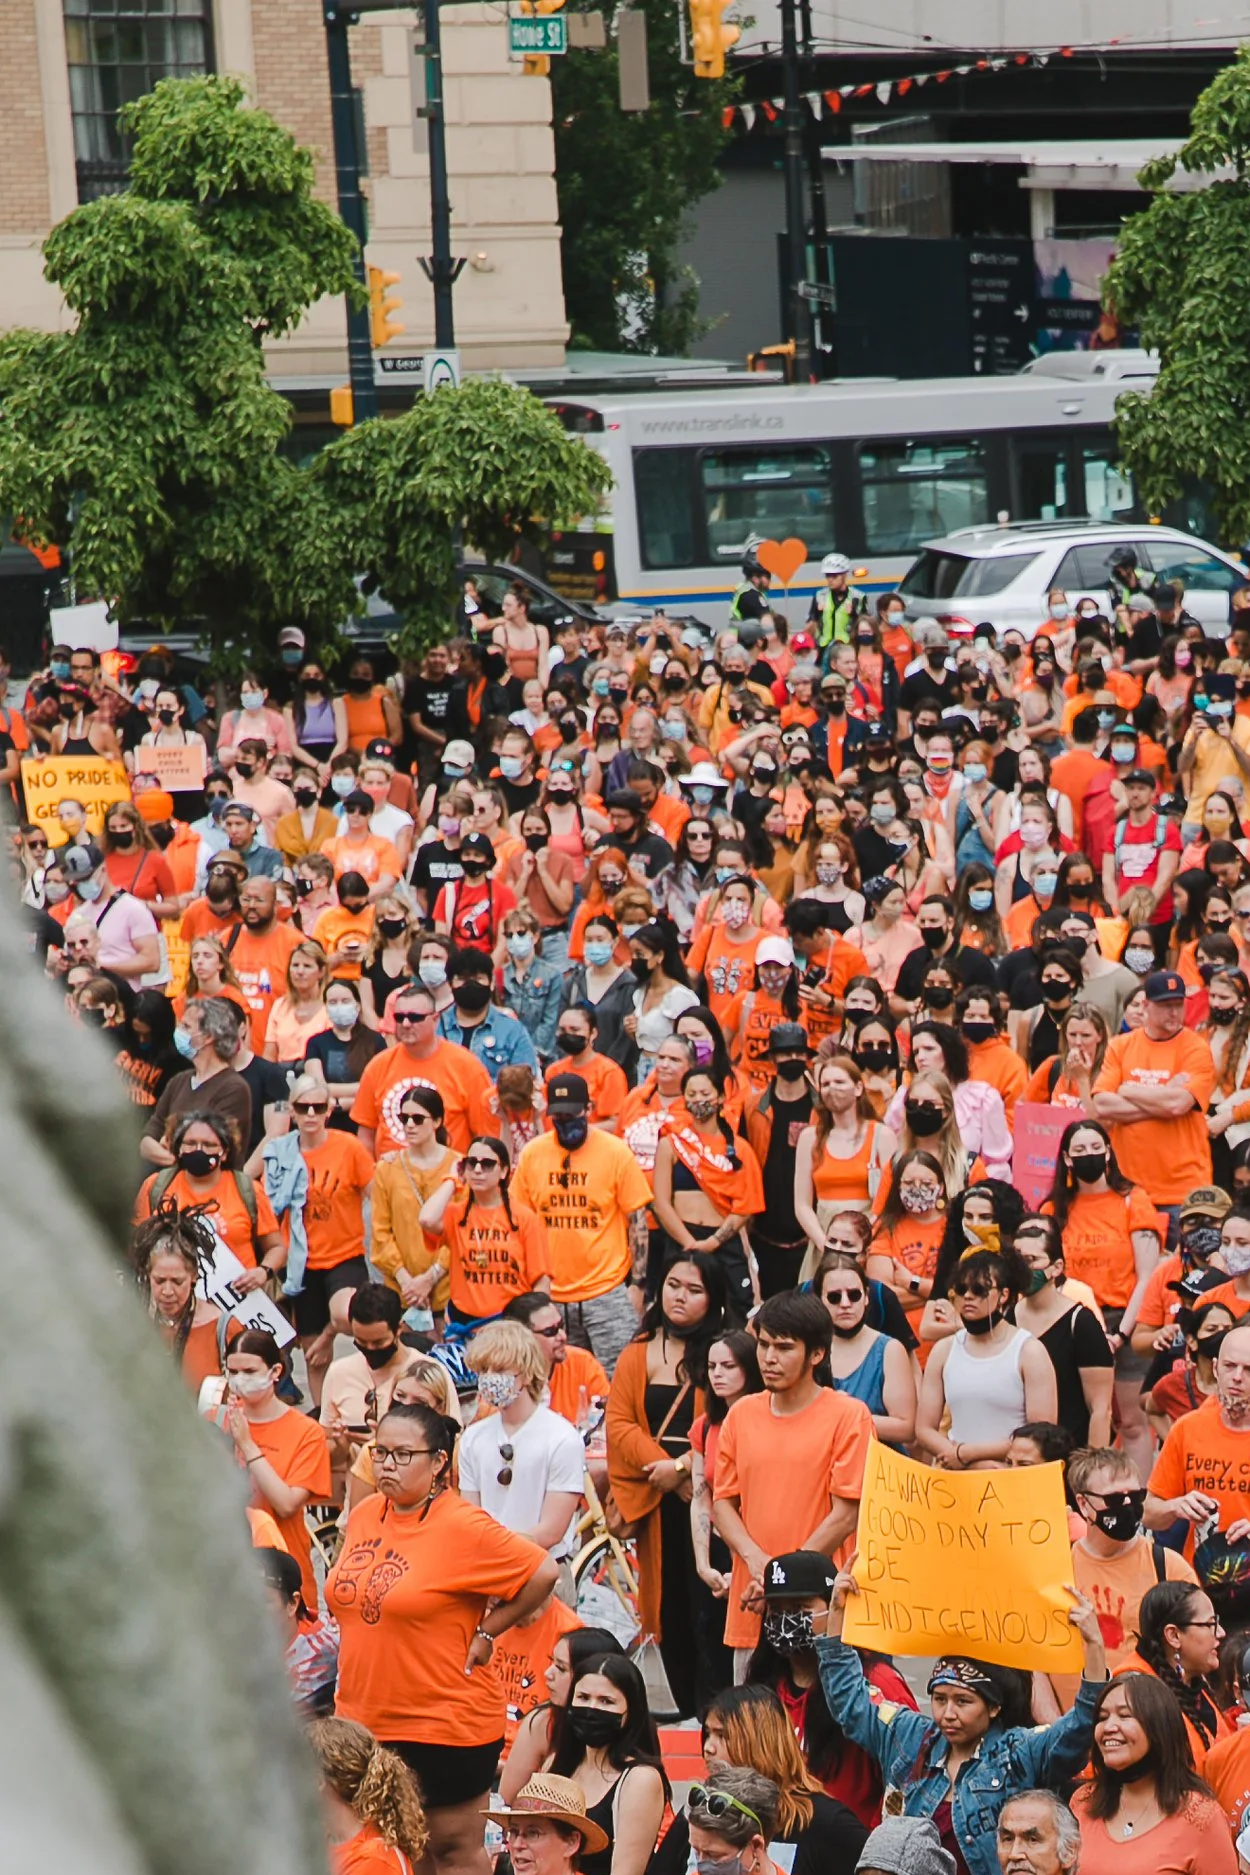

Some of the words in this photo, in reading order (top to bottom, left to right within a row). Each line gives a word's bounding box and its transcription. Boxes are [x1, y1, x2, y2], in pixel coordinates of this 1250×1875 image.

[548, 21, 562, 47] St
[29, 770, 58, 789] NO
[68, 770, 111, 786] PRIDE
[551, 1195, 588, 1208] CHILD
[545, 1215, 599, 1229] MATTERS
[469, 1229, 510, 1242] EVERY
[1185, 1453, 1232, 1475] Every
[874, 1463, 956, 1510] ALWAYS
[978, 1481, 1004, 1514] A
[867, 1499, 927, 1545] GOOD
[937, 1521, 998, 1550] DAY
[1001, 1517, 1052, 1546] TO
[772, 1561, 786, 1584] LA
[867, 1539, 911, 1584] BE
[855, 1588, 1073, 1646] INDIGENOUS
